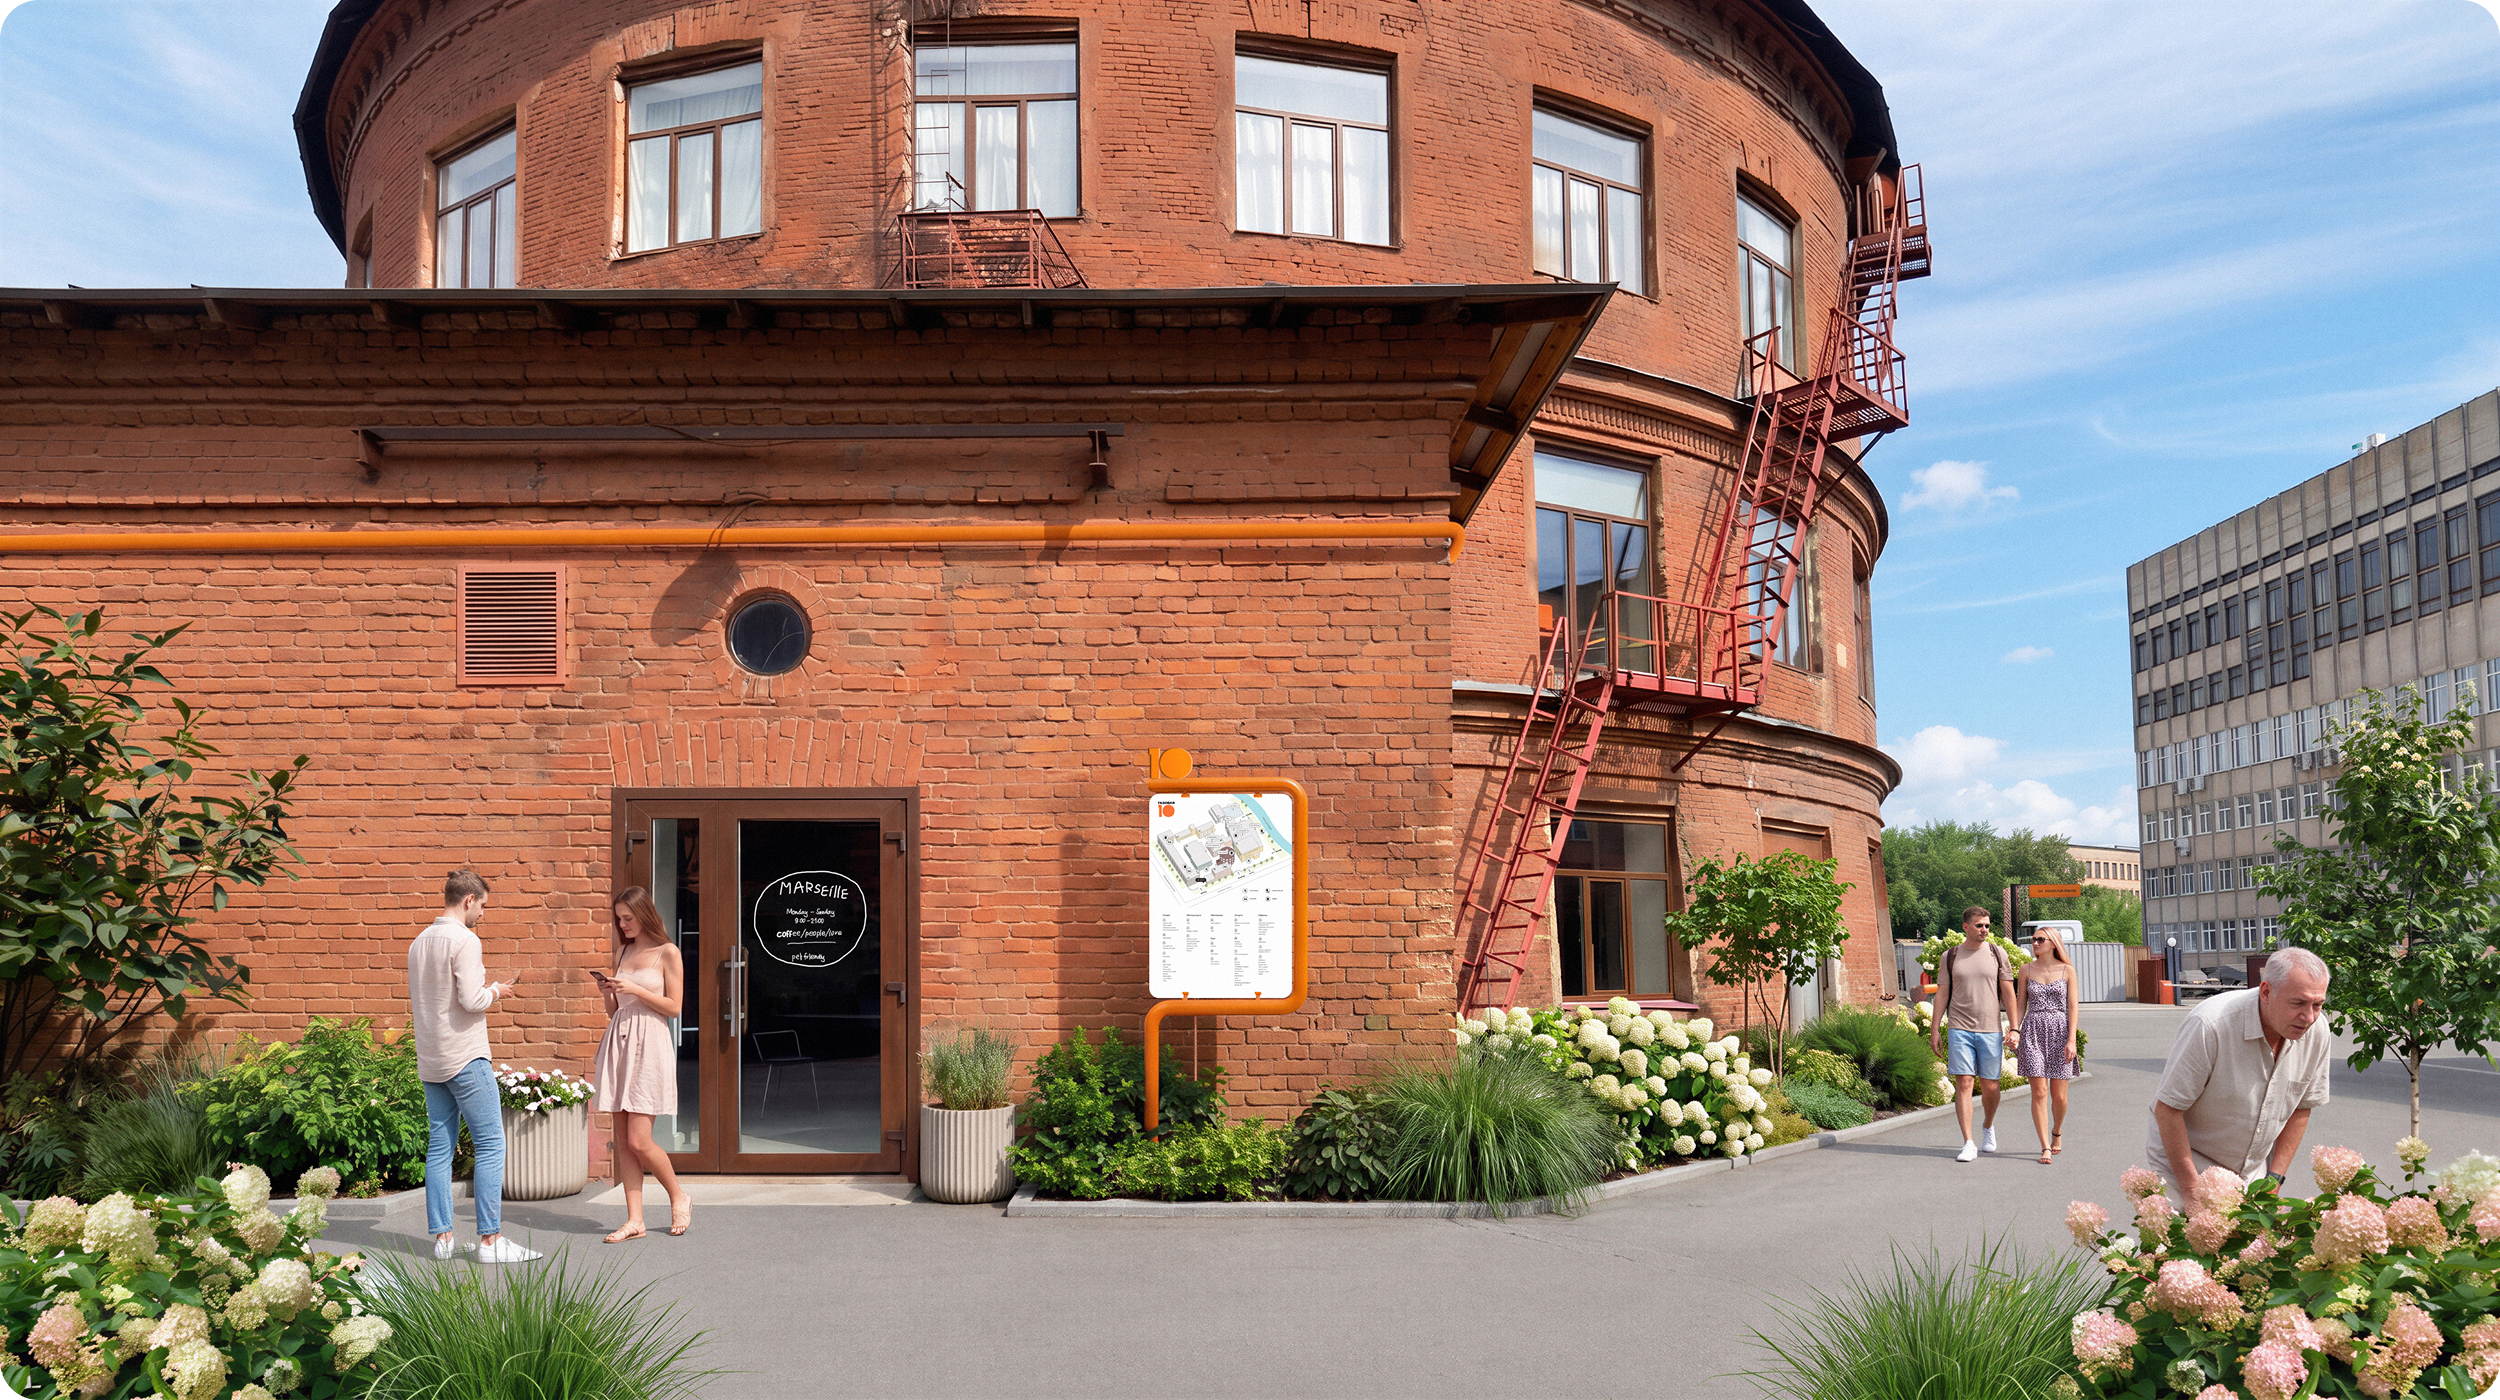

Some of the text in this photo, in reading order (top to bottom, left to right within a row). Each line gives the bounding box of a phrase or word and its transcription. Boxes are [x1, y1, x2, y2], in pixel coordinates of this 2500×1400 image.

[1148, 747, 1193, 779] 10
[1158, 805, 1175, 818] 10
[786, 908, 808, 918] Monday
[815, 908, 836, 918] Sunday
[791, 952, 826, 963] pet friendly
